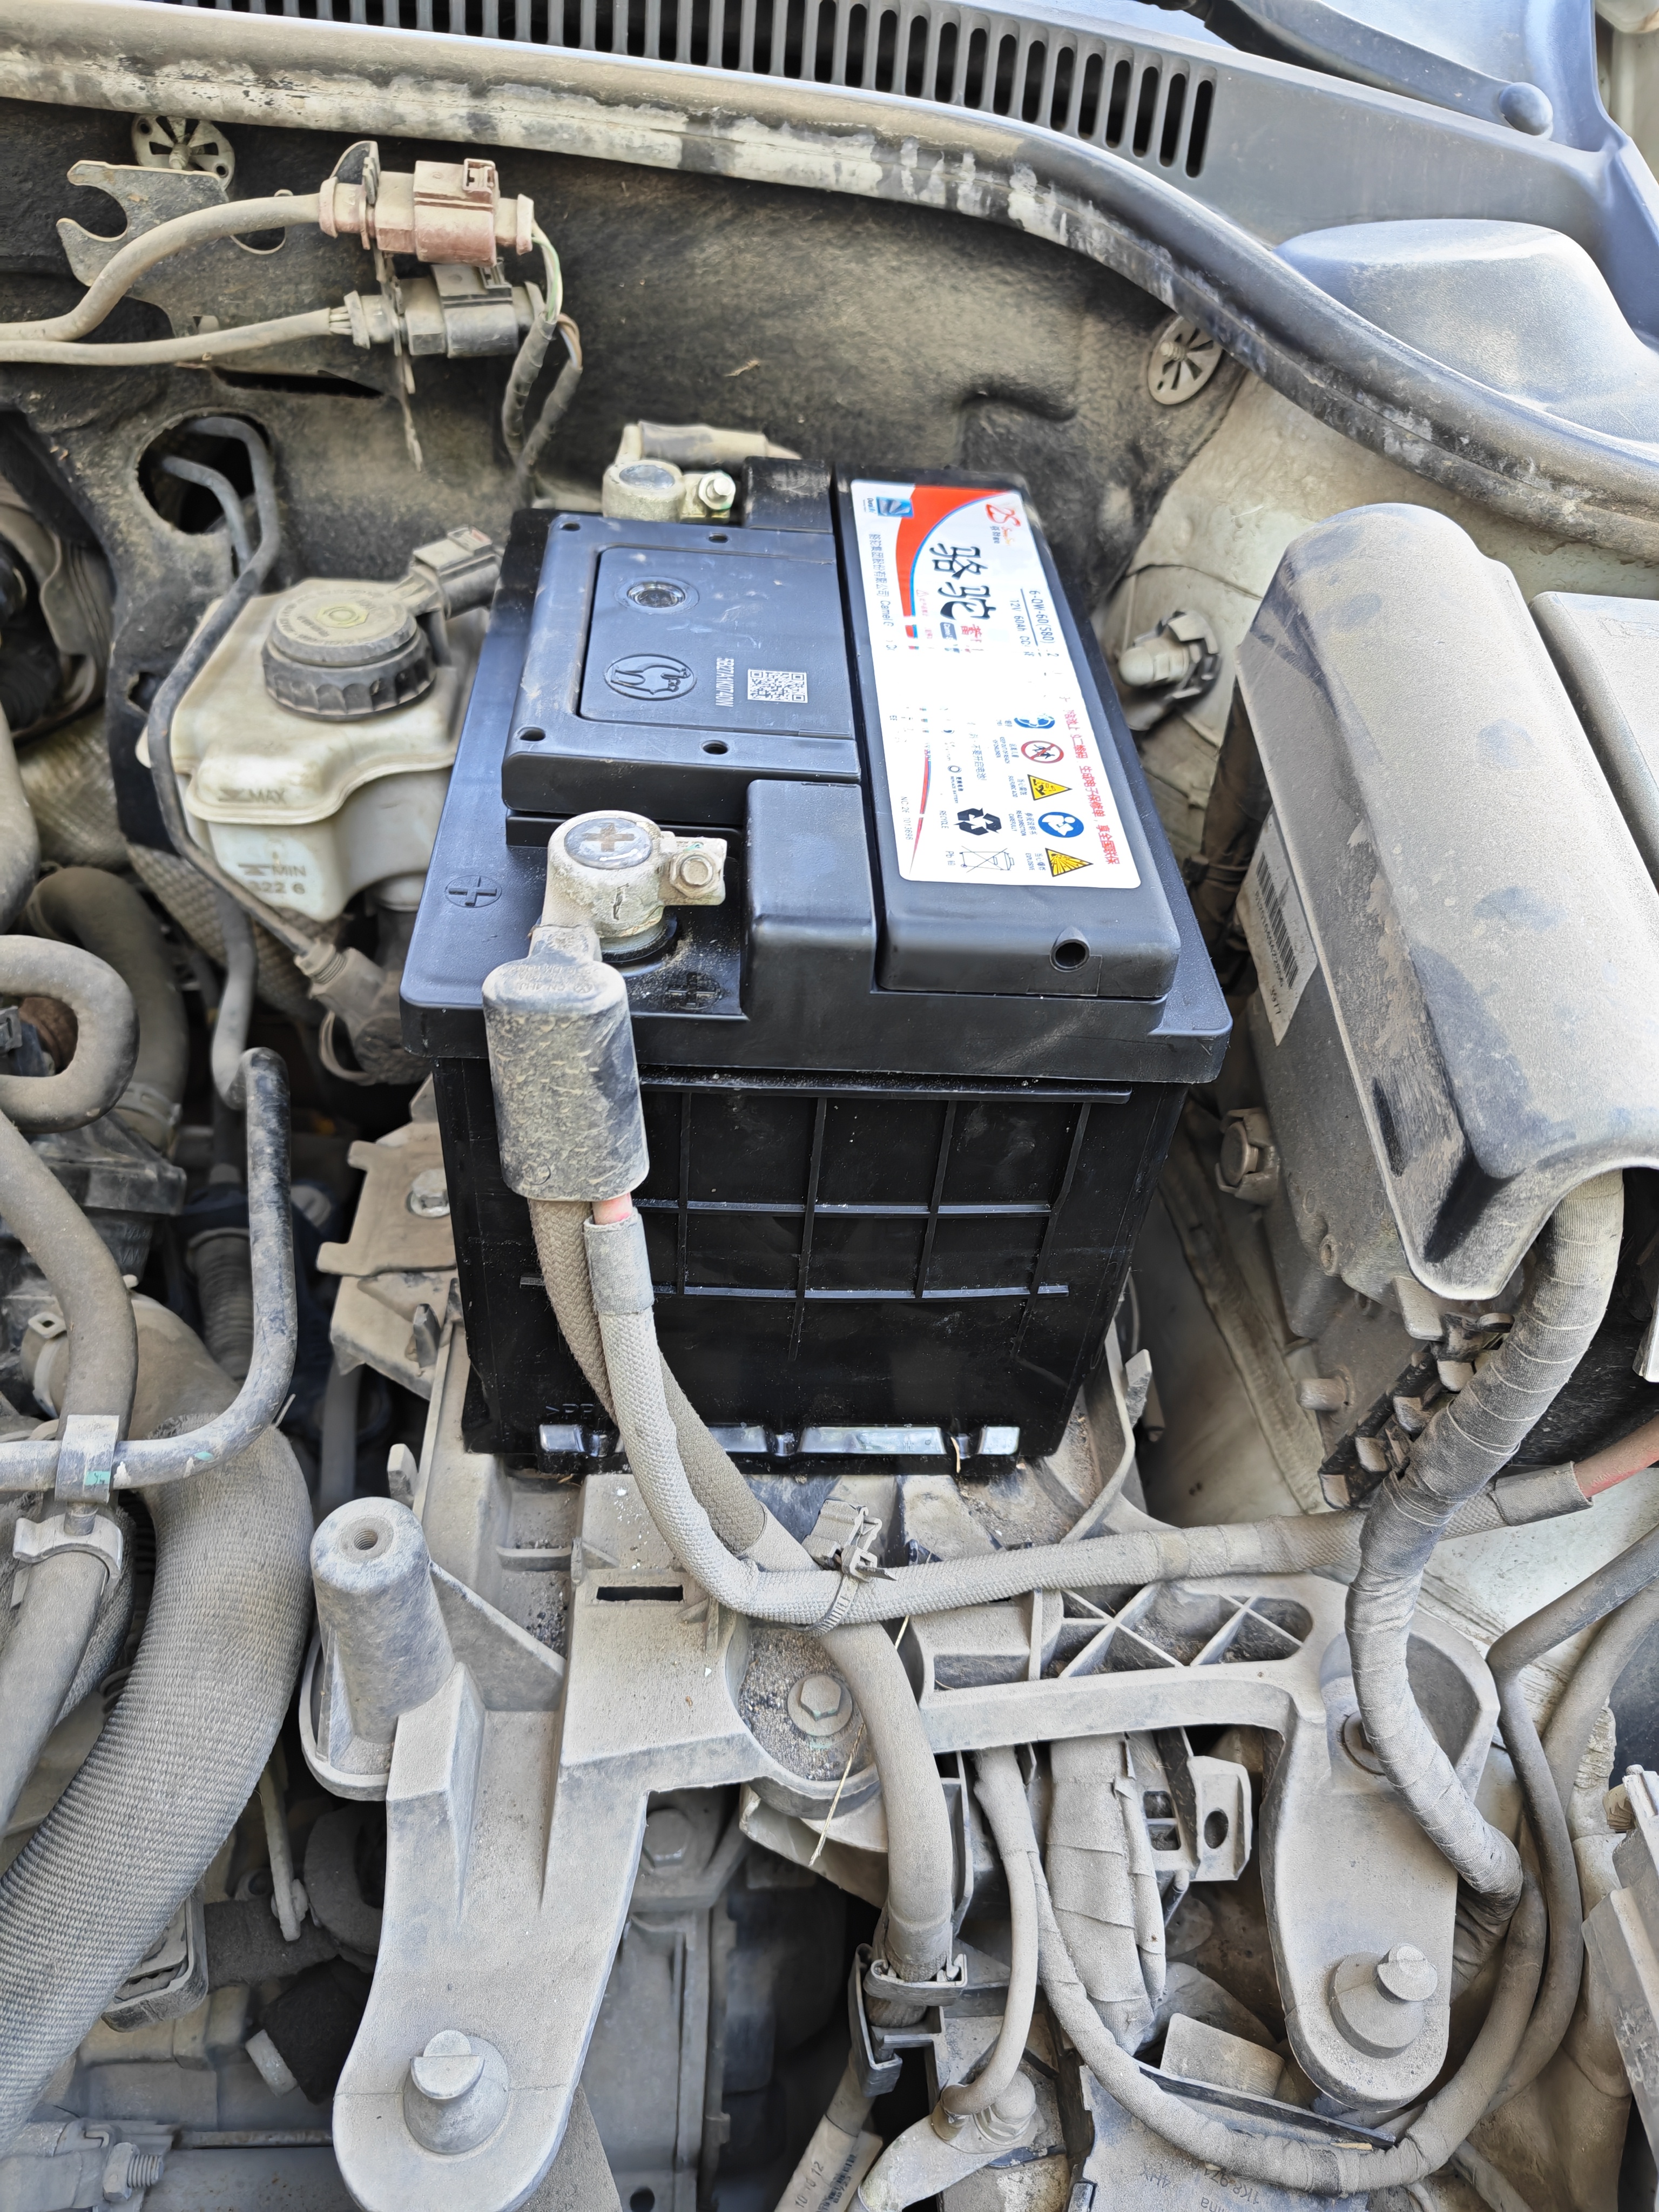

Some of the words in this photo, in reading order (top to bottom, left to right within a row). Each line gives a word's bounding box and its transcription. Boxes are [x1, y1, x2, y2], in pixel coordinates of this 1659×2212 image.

[929, 542, 997, 621] 骆驼
[879, 599, 893, 621] Camel
[1008, 598, 1022, 611] 12V
[1013, 615, 1028, 632] 60Ah
[248, 788, 288, 804] MAX
[938, 810, 949, 829] RECYCLE
[945, 850, 955, 858] Pb
[1024, 852, 1035, 871] EXPLOSIVE
[272, 864, 306, 877] MIN
